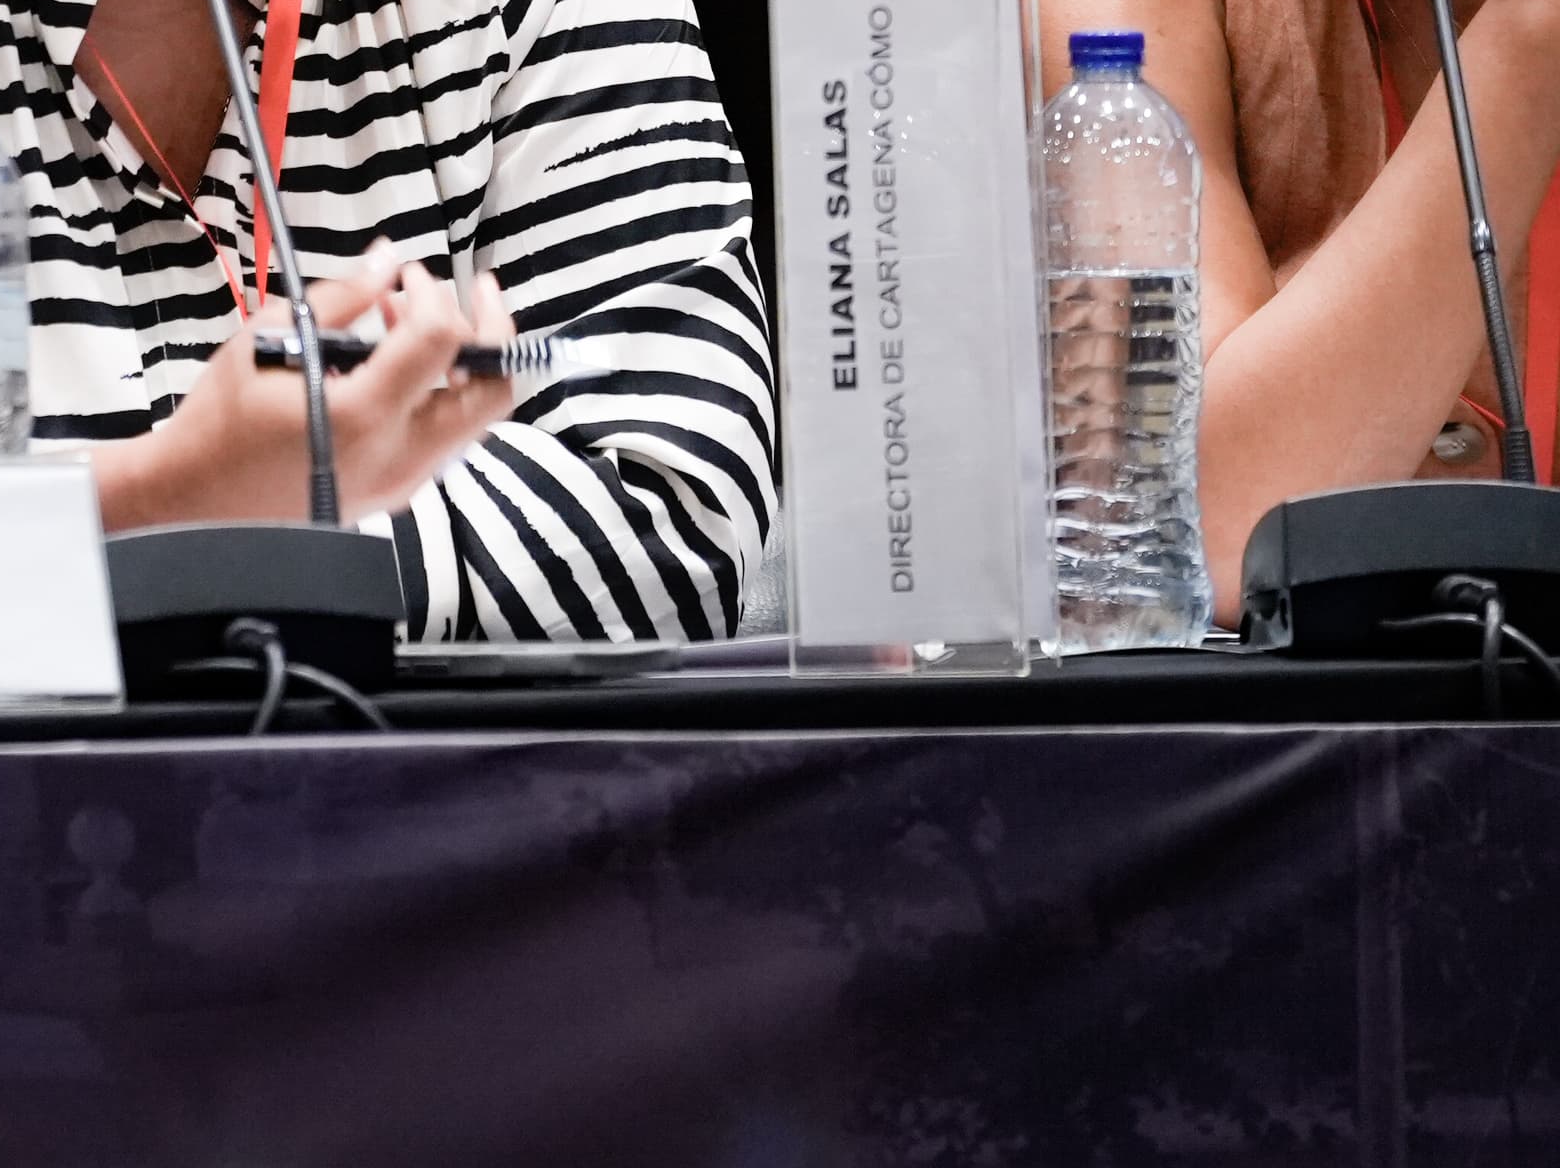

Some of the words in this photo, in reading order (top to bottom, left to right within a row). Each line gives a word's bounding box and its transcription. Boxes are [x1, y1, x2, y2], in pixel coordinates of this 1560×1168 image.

[864, 6, 892, 110] CÓMO
[822, 79, 851, 218] SALAS
[871, 120, 901, 329] CARTAGENA
[828, 233, 858, 390] ELIANA
[880, 340, 905, 383] DE
[880, 392, 914, 592] DIRECTORA
